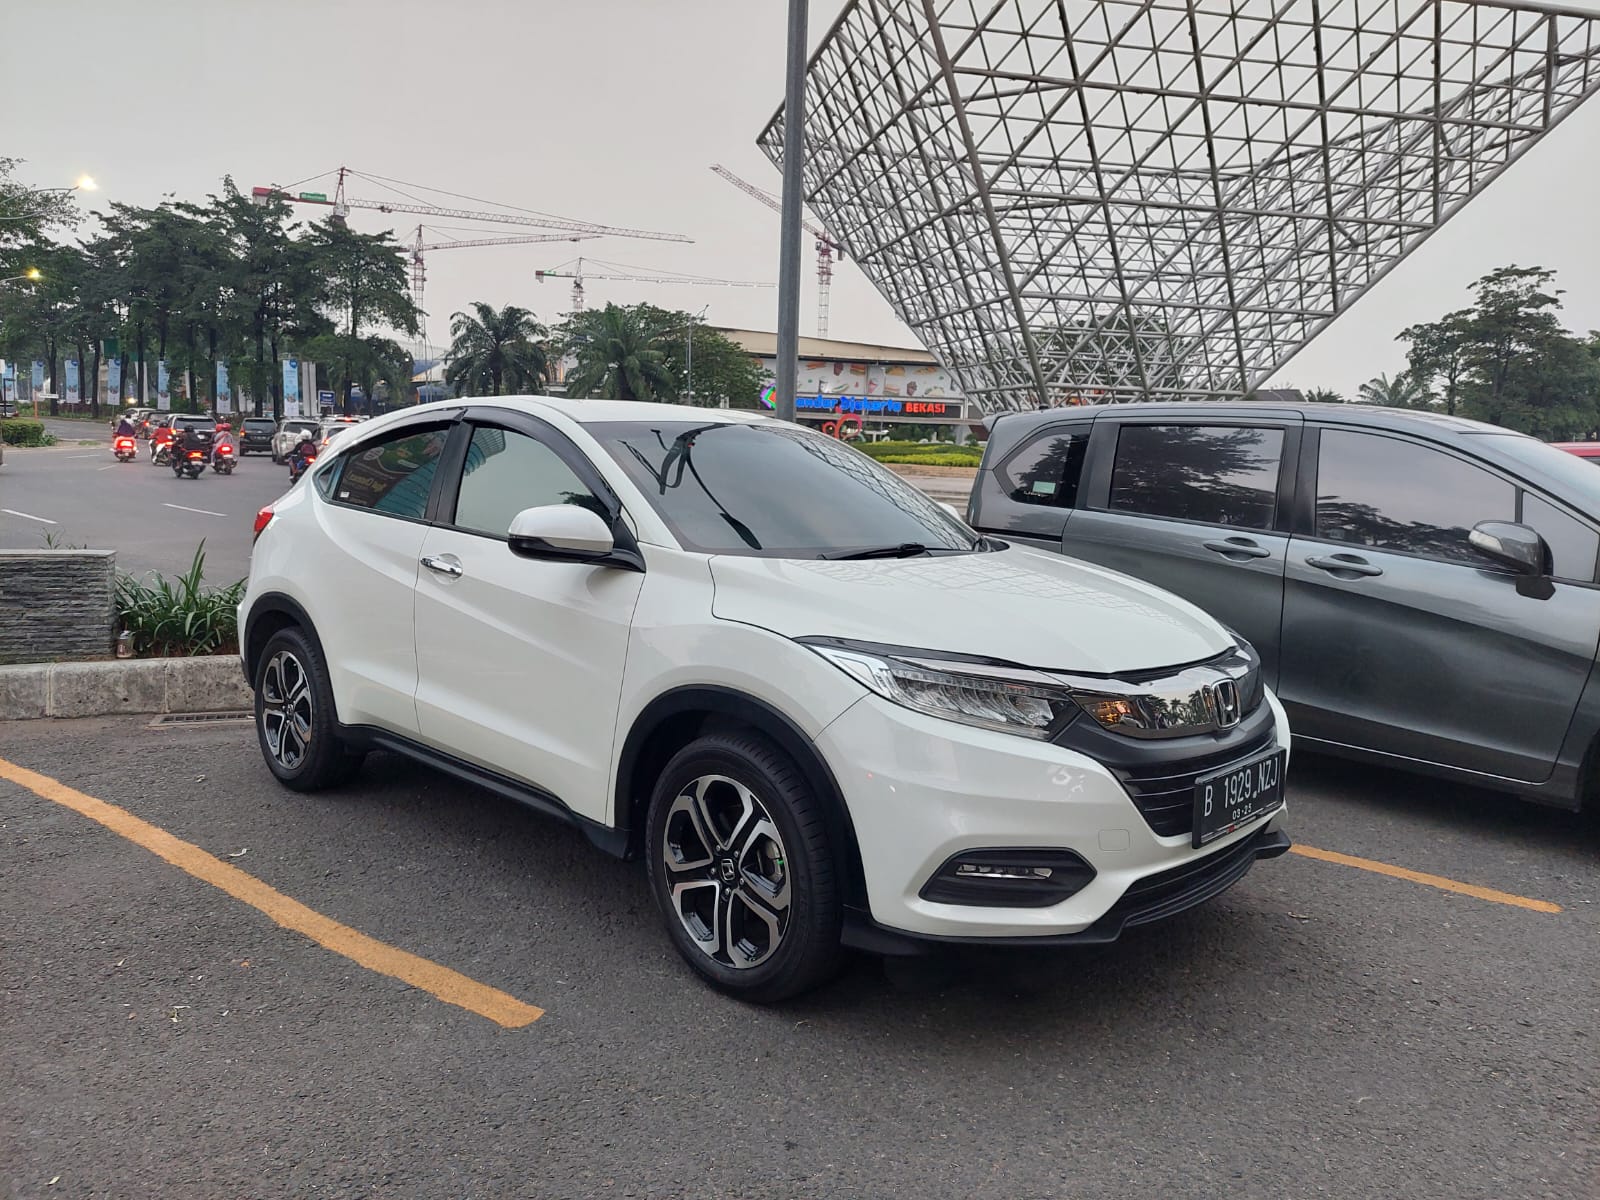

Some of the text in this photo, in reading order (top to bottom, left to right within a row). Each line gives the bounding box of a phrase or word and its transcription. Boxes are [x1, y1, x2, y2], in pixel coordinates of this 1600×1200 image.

[795, 395, 838, 408] andar
[905, 402, 946, 413] BEKASI
[1204, 757, 1278, 817] B 1929 NZJ
